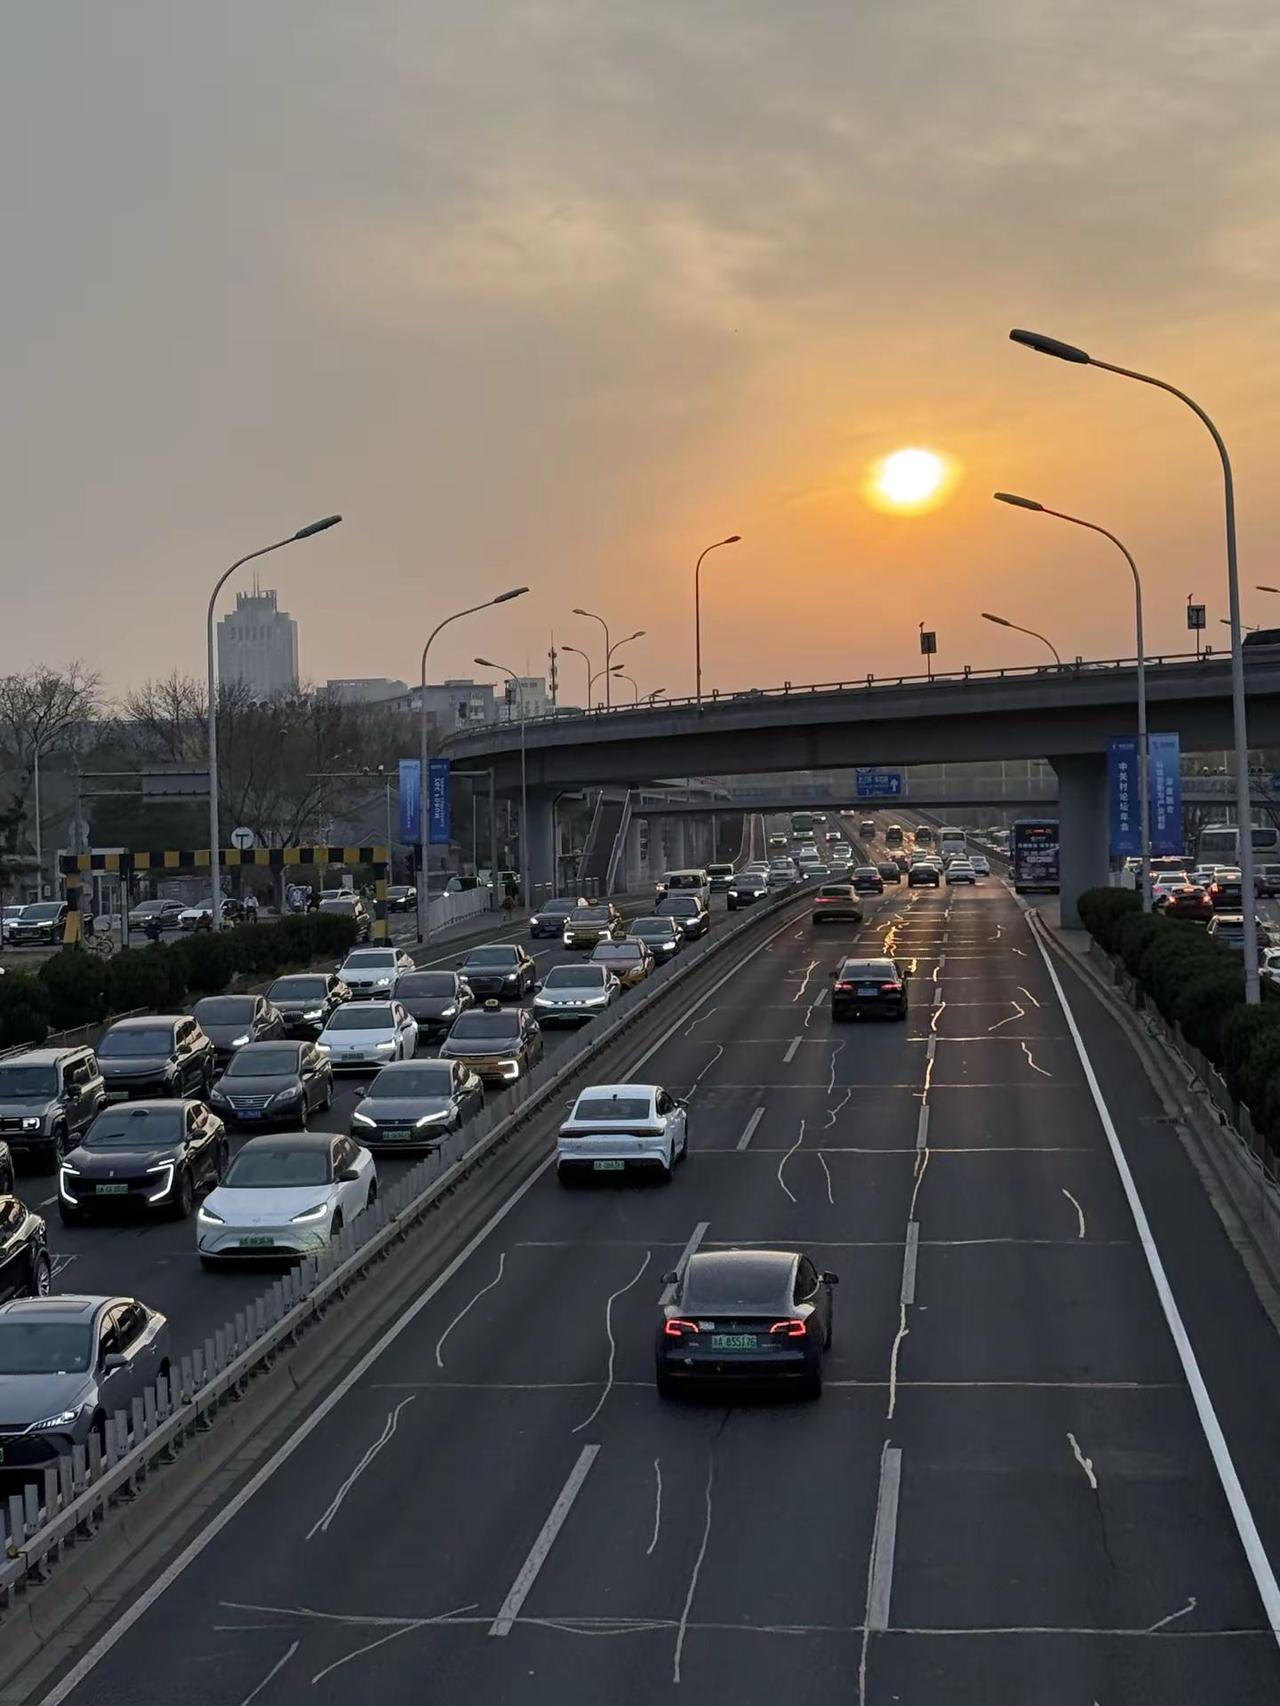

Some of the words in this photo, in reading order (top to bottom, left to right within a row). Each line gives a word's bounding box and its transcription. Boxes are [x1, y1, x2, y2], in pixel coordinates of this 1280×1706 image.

[1118, 762, 1129, 832] 中关村论坛年会
